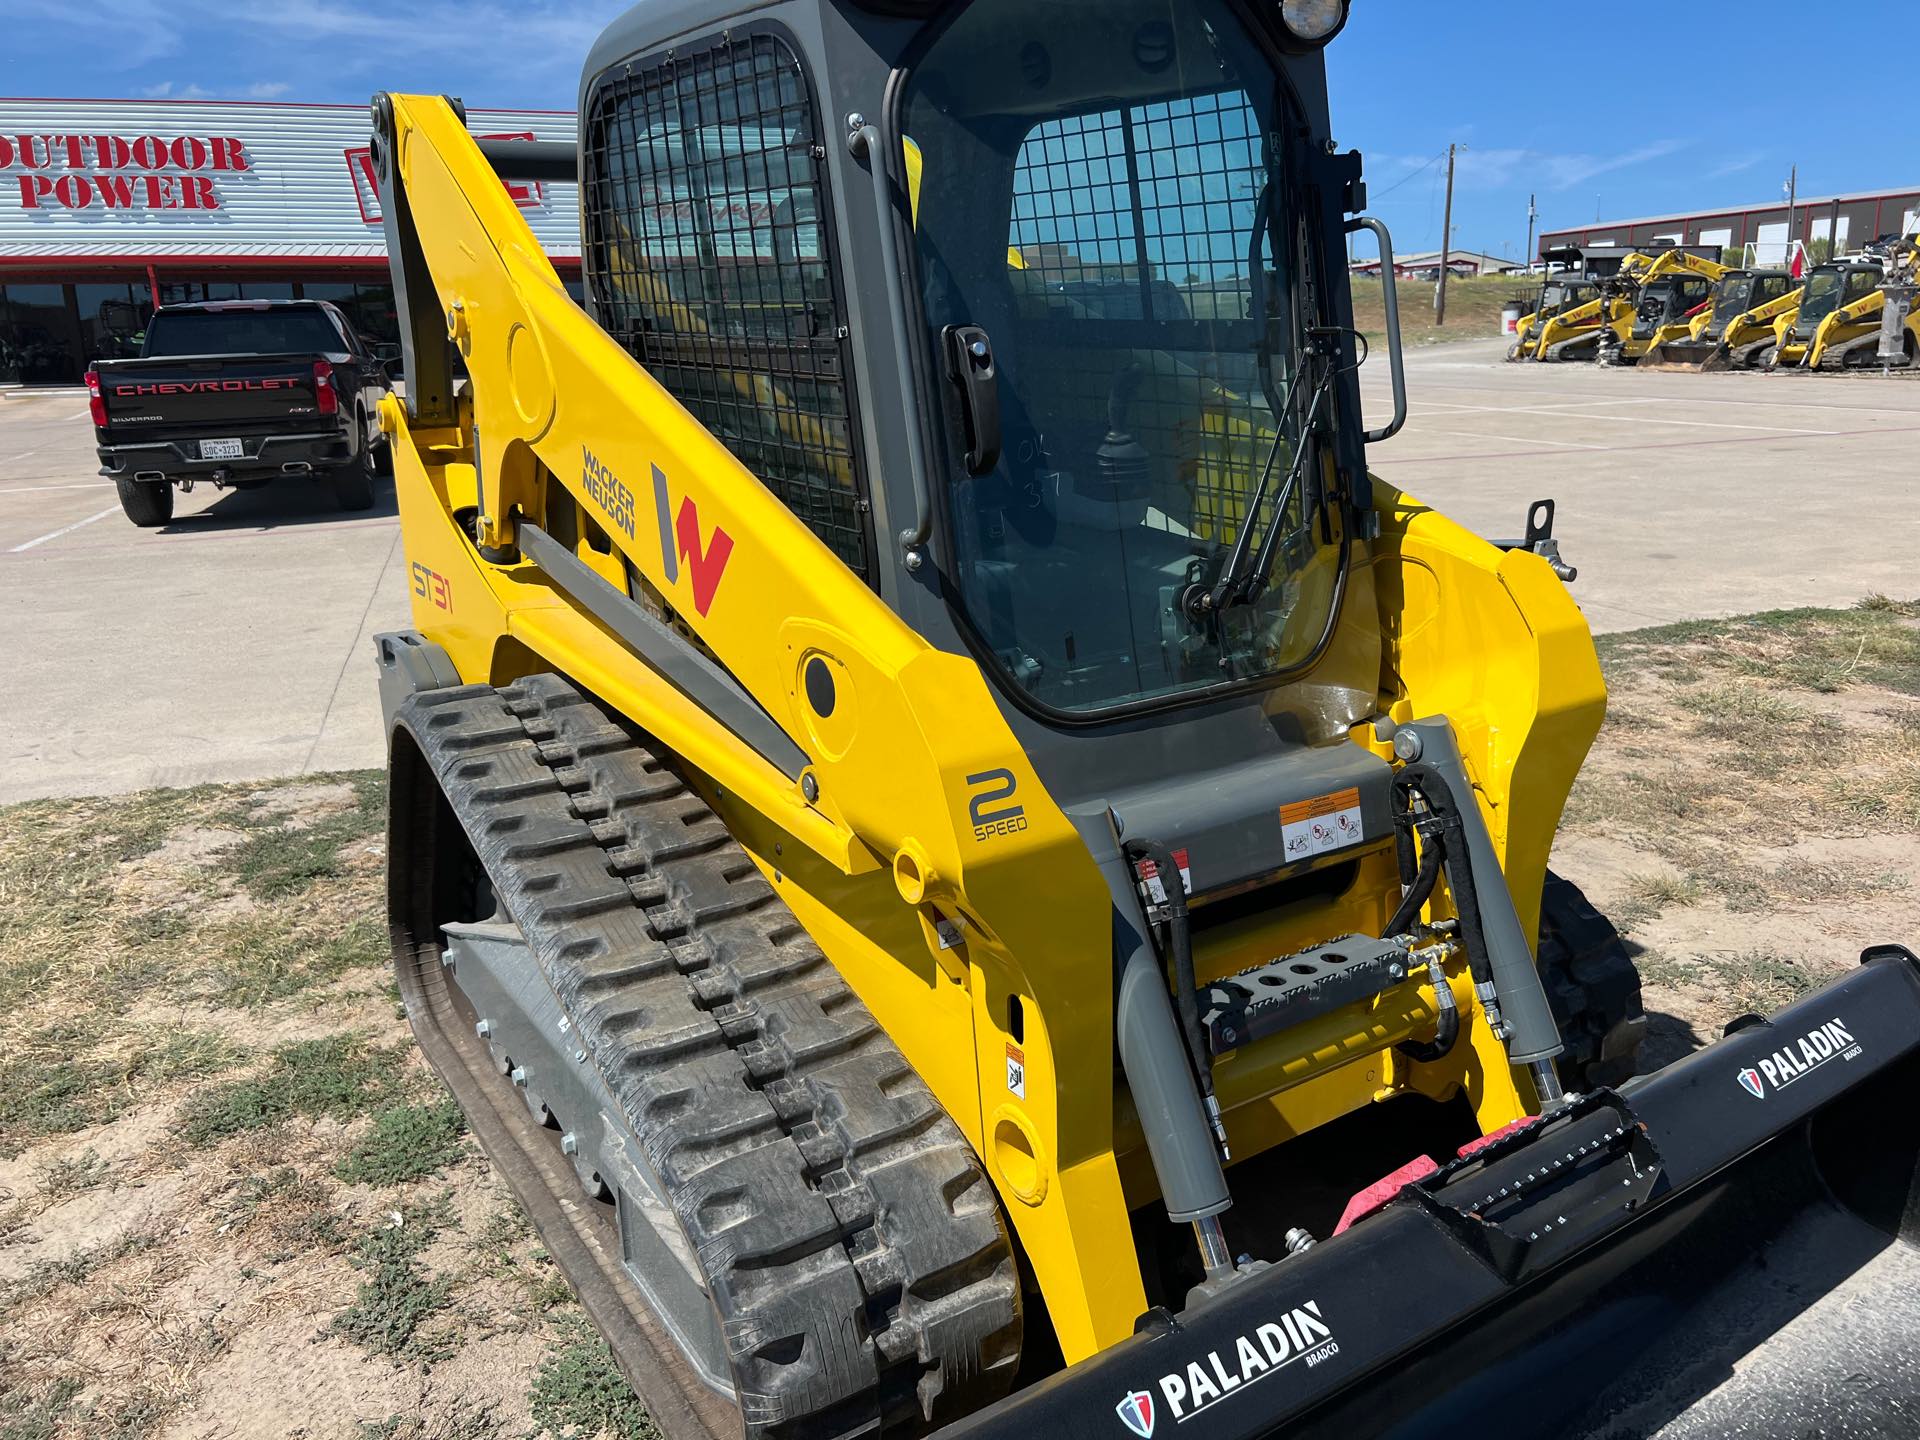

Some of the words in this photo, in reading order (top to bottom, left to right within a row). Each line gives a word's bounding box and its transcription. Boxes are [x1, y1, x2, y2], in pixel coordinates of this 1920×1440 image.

[16, 174, 220, 210] POWER
[116, 378, 299, 397] CHEVROLET
[111, 415, 164, 424] SILVERADO
[582, 444, 635, 518] WACKER
[582, 468, 635, 541] NEUSON
[412, 561, 453, 615] ST31
[965, 767, 1025, 828] 2
[974, 816, 1028, 842] SPEED
[1758, 1017, 1855, 1088] PALADIN
[1158, 1299, 1332, 1419] PALADIN
[1305, 1341, 1340, 1369] BRADCO
